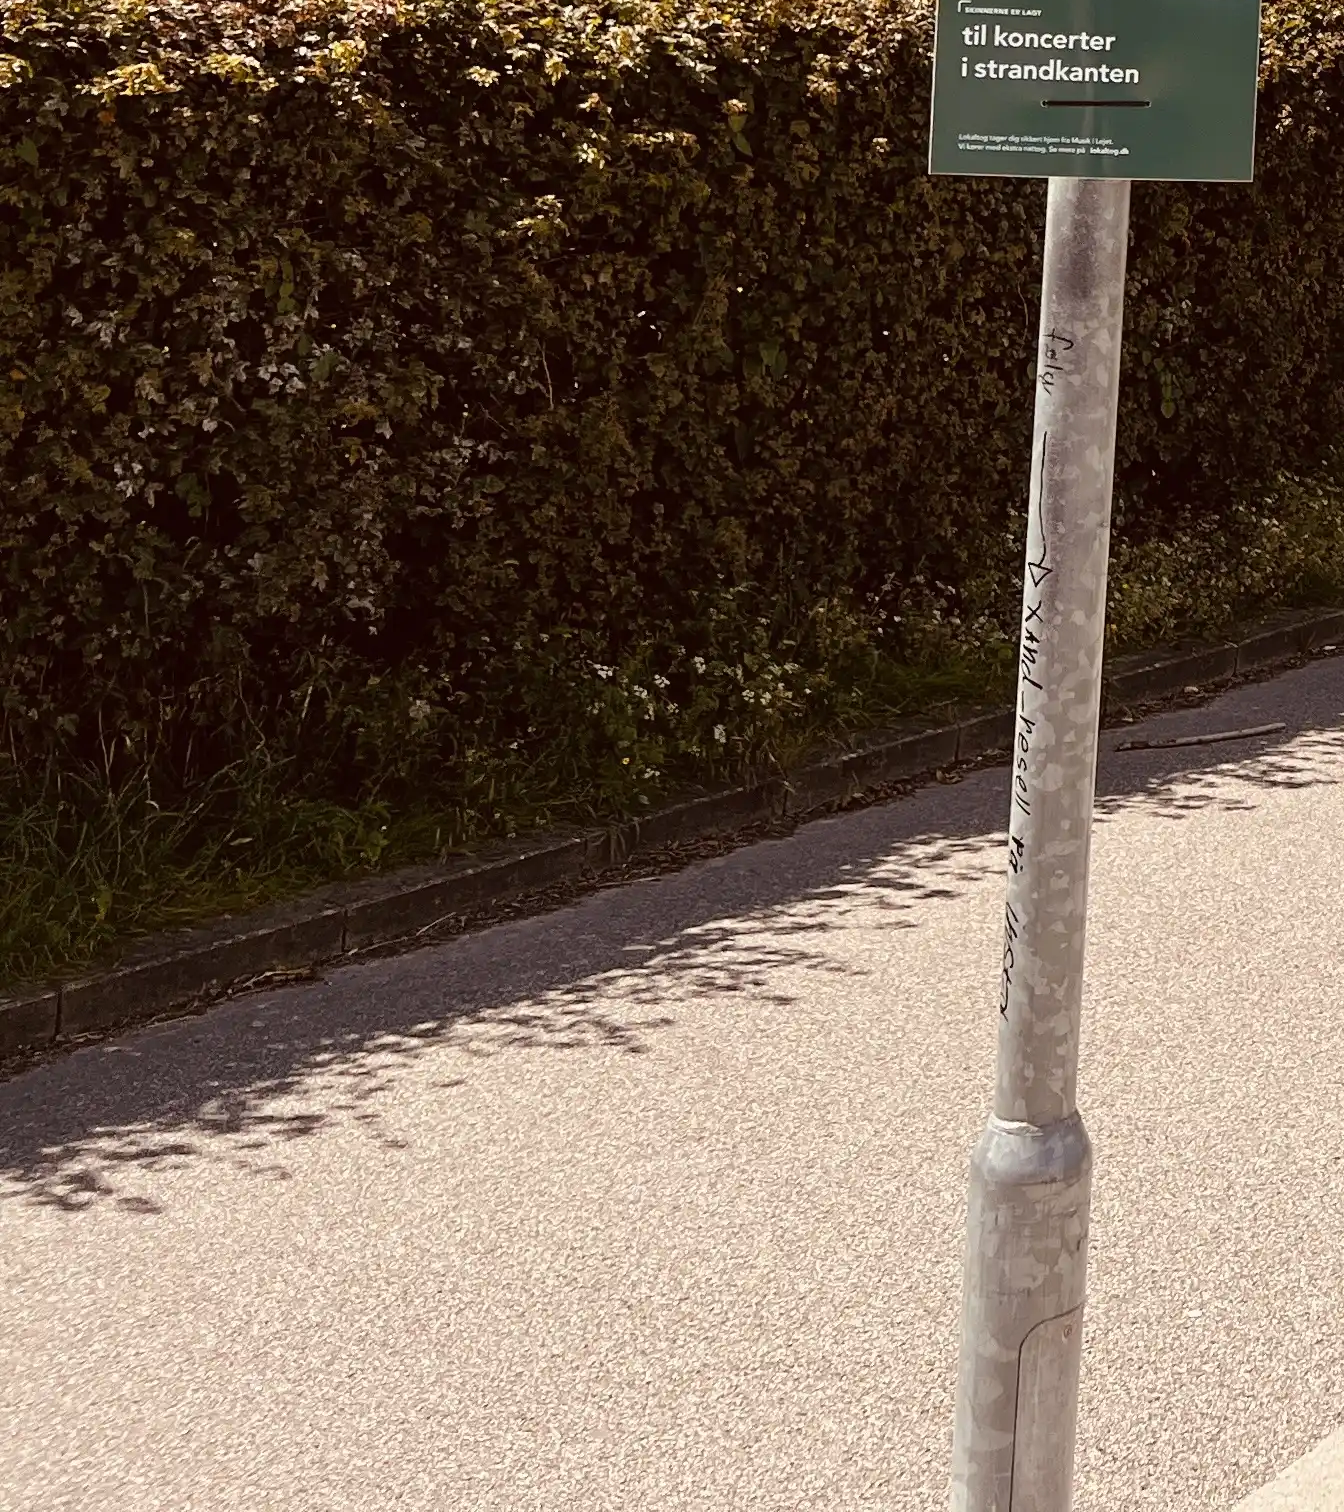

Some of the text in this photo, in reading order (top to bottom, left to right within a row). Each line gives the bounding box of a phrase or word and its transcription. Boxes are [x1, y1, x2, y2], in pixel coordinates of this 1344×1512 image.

[962, 24, 1116, 51] til koncerter
[961, 56, 1139, 83] i strandkanten
